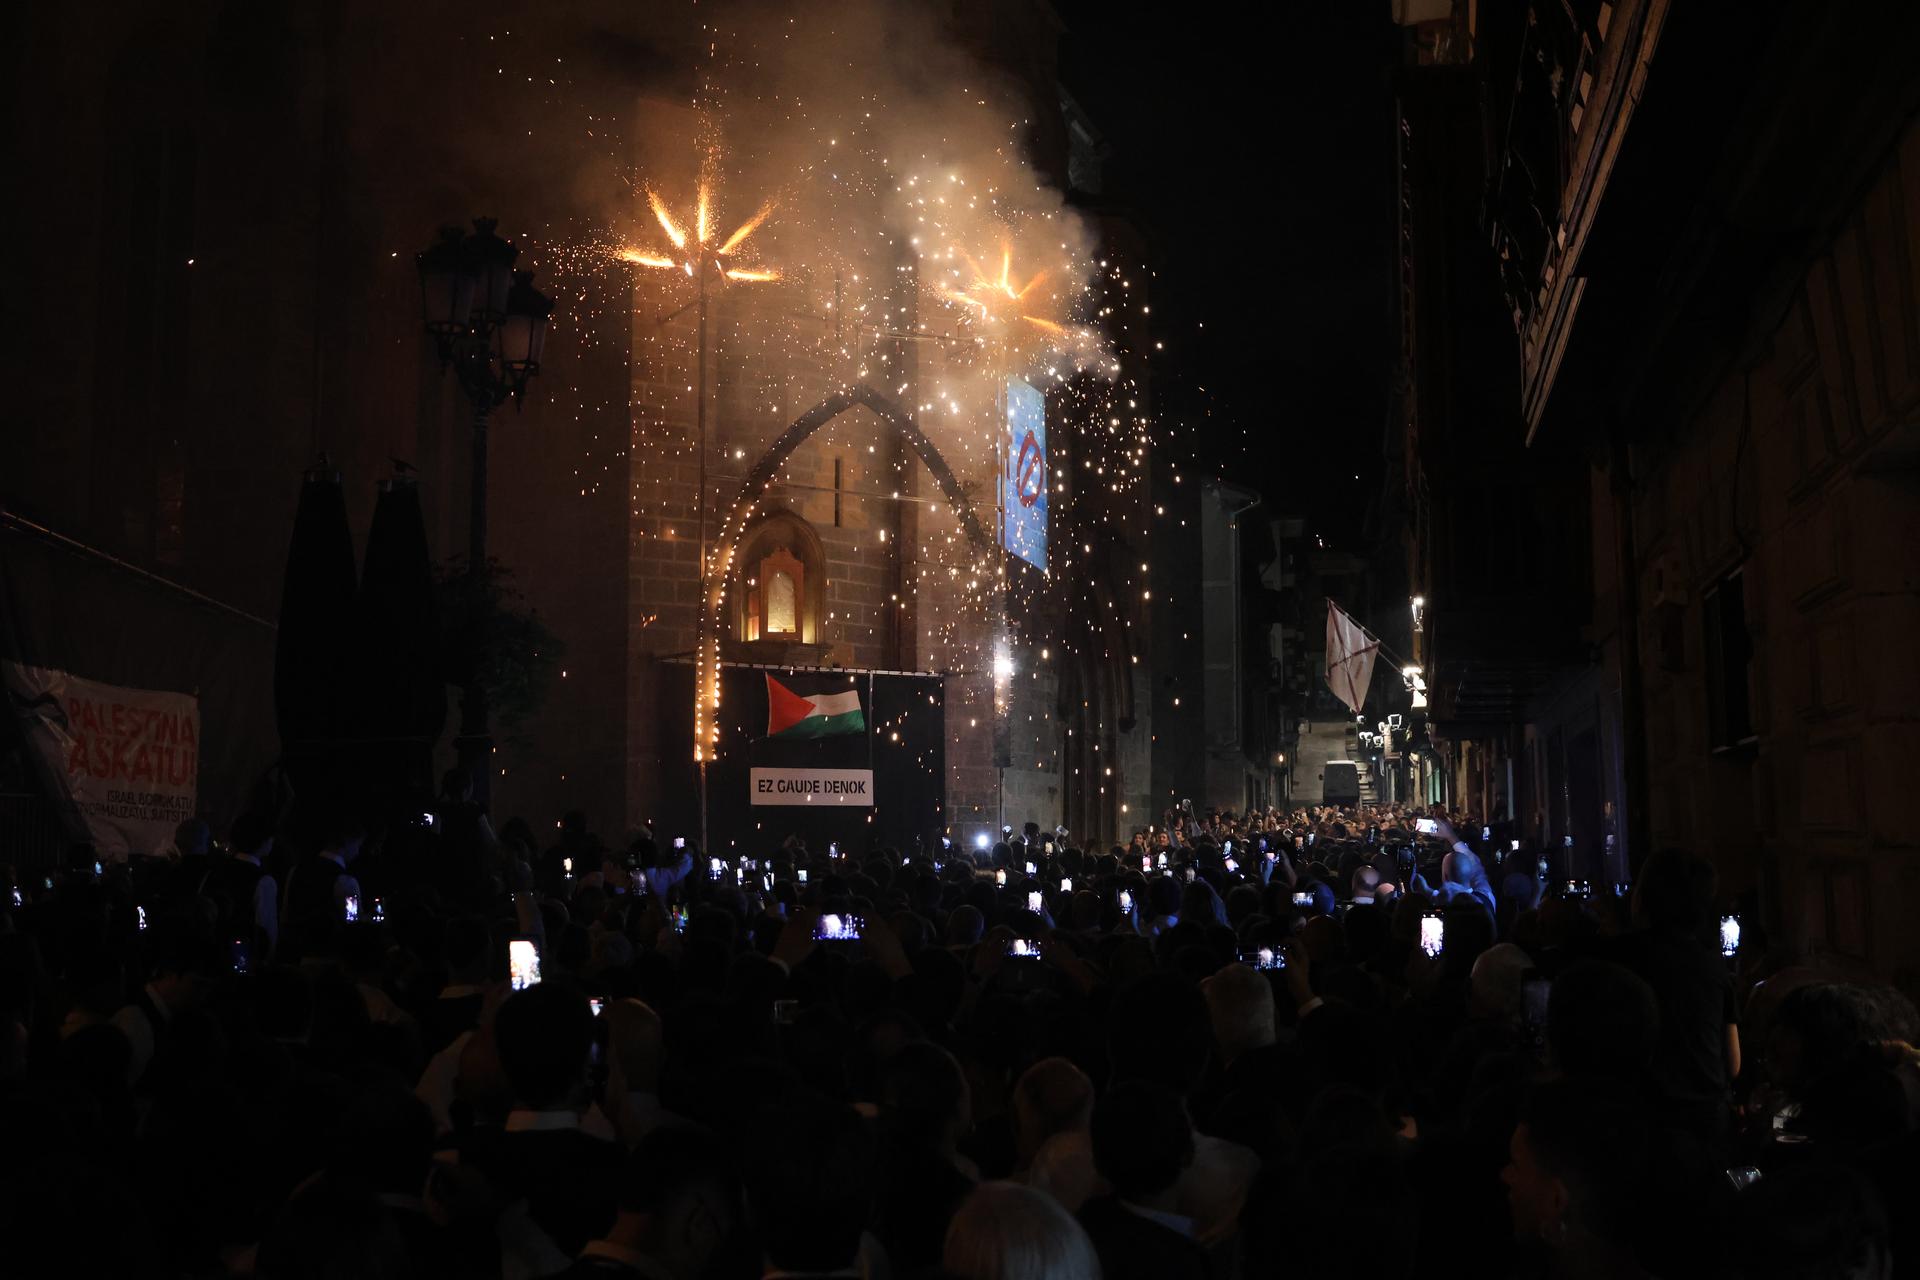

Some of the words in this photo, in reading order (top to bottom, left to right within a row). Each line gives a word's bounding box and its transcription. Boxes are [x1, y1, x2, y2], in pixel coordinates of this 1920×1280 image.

[69, 697, 196, 750] PALESTINA
[758, 779, 773, 793] EZ
[777, 779, 819, 793] GAUDE
[824, 780, 866, 794] DENOK
[108, 791, 136, 805] ISRAEL
